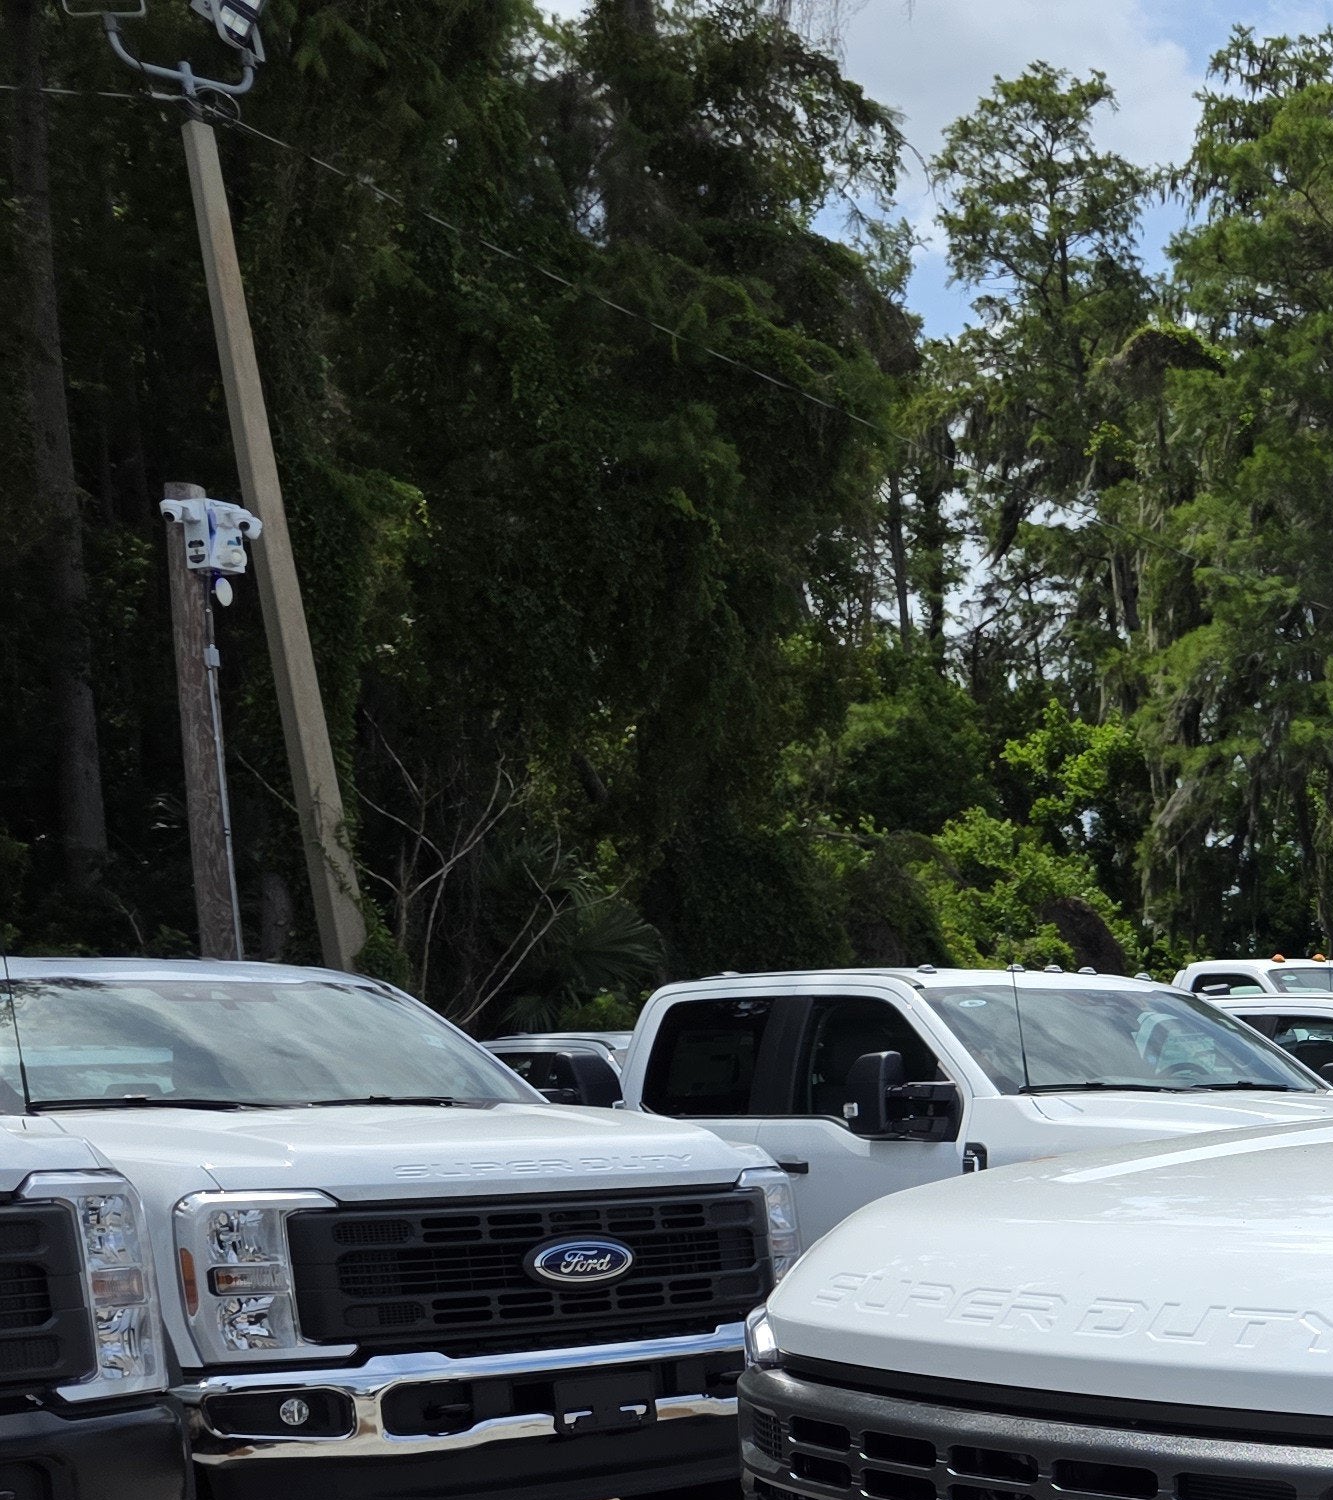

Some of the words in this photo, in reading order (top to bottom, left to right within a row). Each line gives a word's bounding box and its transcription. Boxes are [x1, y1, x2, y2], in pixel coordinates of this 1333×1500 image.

[393, 1160, 573, 1180] SUPER
[579, 1153, 692, 1172] DUTY
[560, 1249, 612, 1274] Ford
[814, 1271, 1069, 1333] SUPER
